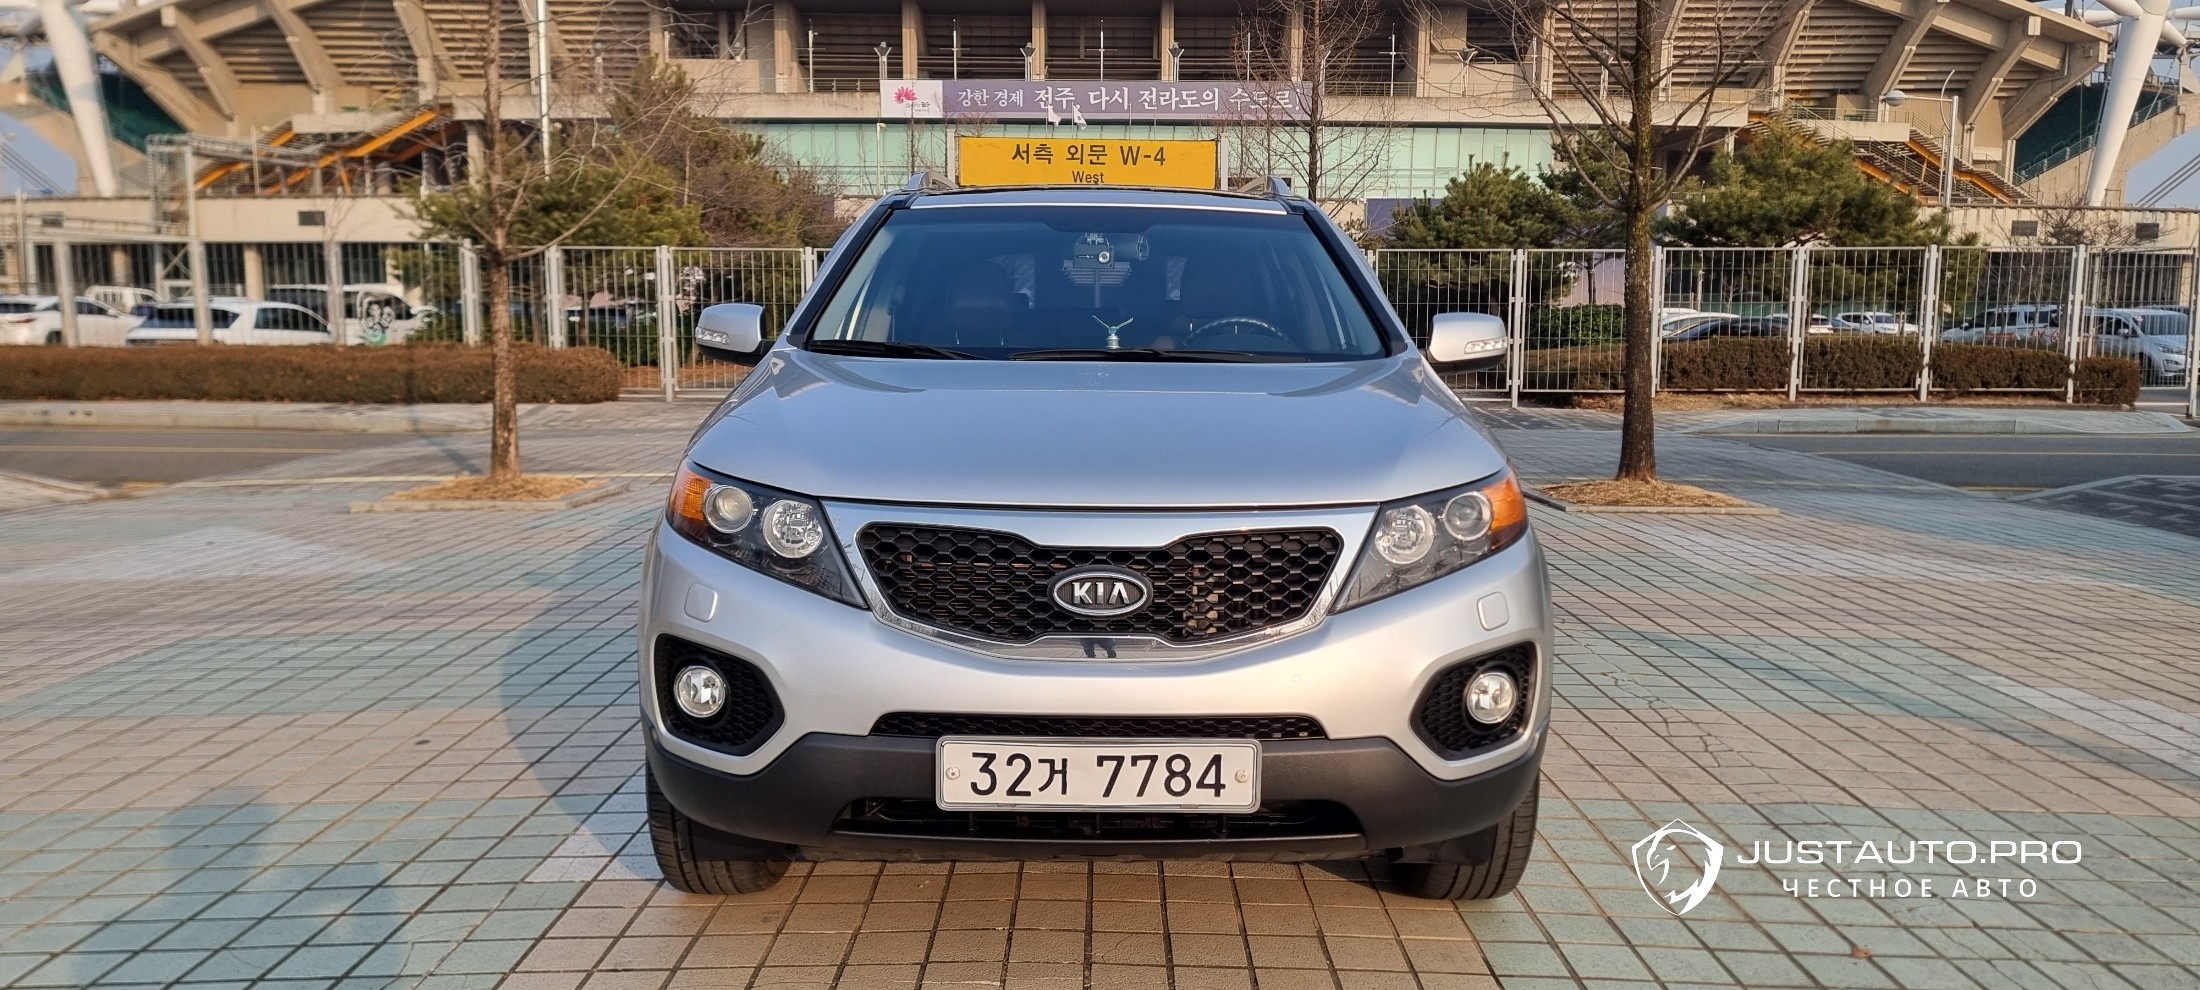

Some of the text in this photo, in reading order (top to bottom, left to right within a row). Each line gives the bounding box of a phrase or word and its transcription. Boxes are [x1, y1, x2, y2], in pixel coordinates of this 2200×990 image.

[957, 88, 990, 107] 강한
[993, 88, 1024, 108] 경제
[1088, 86, 1129, 111] 다시
[1137, 87, 1219, 111] 전라도의
[1011, 143, 1166, 167] 서측 외문 W-4
[1071, 170, 1105, 184] West
[1072, 581, 1131, 604] KIA
[970, 752, 1226, 798] 32거 7784
